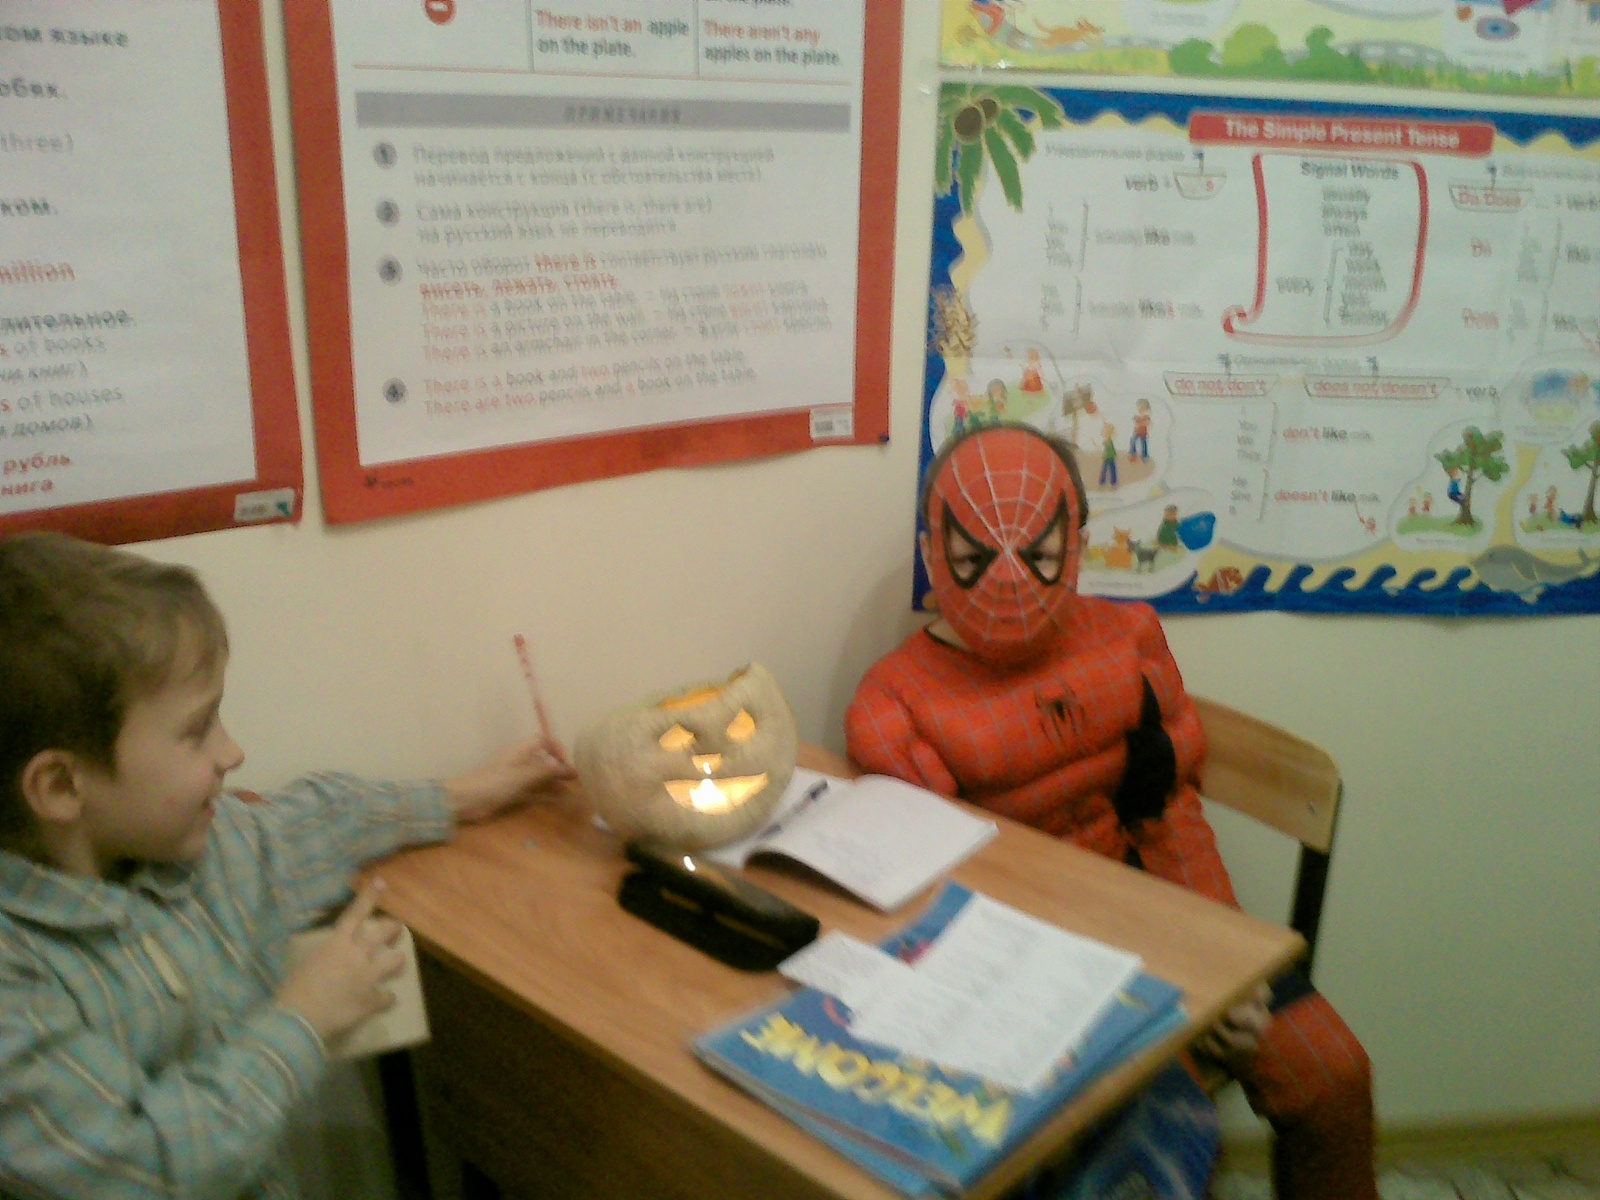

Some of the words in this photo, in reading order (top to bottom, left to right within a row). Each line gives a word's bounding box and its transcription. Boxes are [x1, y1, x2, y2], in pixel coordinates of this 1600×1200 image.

[535, 9, 582, 30] There
[587, 14, 620, 32] isn't
[623, 19, 642, 34] an
[648, 19, 689, 38] apple
[704, 19, 745, 39] There
[794, 28, 820, 47] any
[537, 38, 559, 54] on
[561, 37, 589, 55] the
[704, 46, 750, 65] apples
[754, 48, 772, 62] on
[775, 47, 798, 63] the
[1225, 119, 1259, 138] The
[1263, 121, 1327, 142] Simple
[1331, 123, 1403, 145] Present
[1408, 127, 1461, 148] Tense
[1301, 161, 1348, 179] Signal
[1351, 163, 1398, 180] Words
[423, 379, 471, 398] There
[506, 368, 544, 387] book
[549, 364, 579, 382] and
[581, 363, 610, 380] two
[664, 355, 682, 371] on
[685, 352, 708, 369] the
[1227, 377, 1267, 393] don't
[423, 400, 472, 420] There
[475, 395, 501, 414] are
[505, 391, 536, 409] two
[594, 382, 622, 398] and
[637, 376, 672, 394] book
[674, 373, 693, 388] on
[696, 370, 719, 387] the
[1282, 426, 1320, 441] don't
[1322, 426, 1348, 441] like
[1273, 488, 1329, 503] doesn't
[1331, 488, 1357, 503] like
